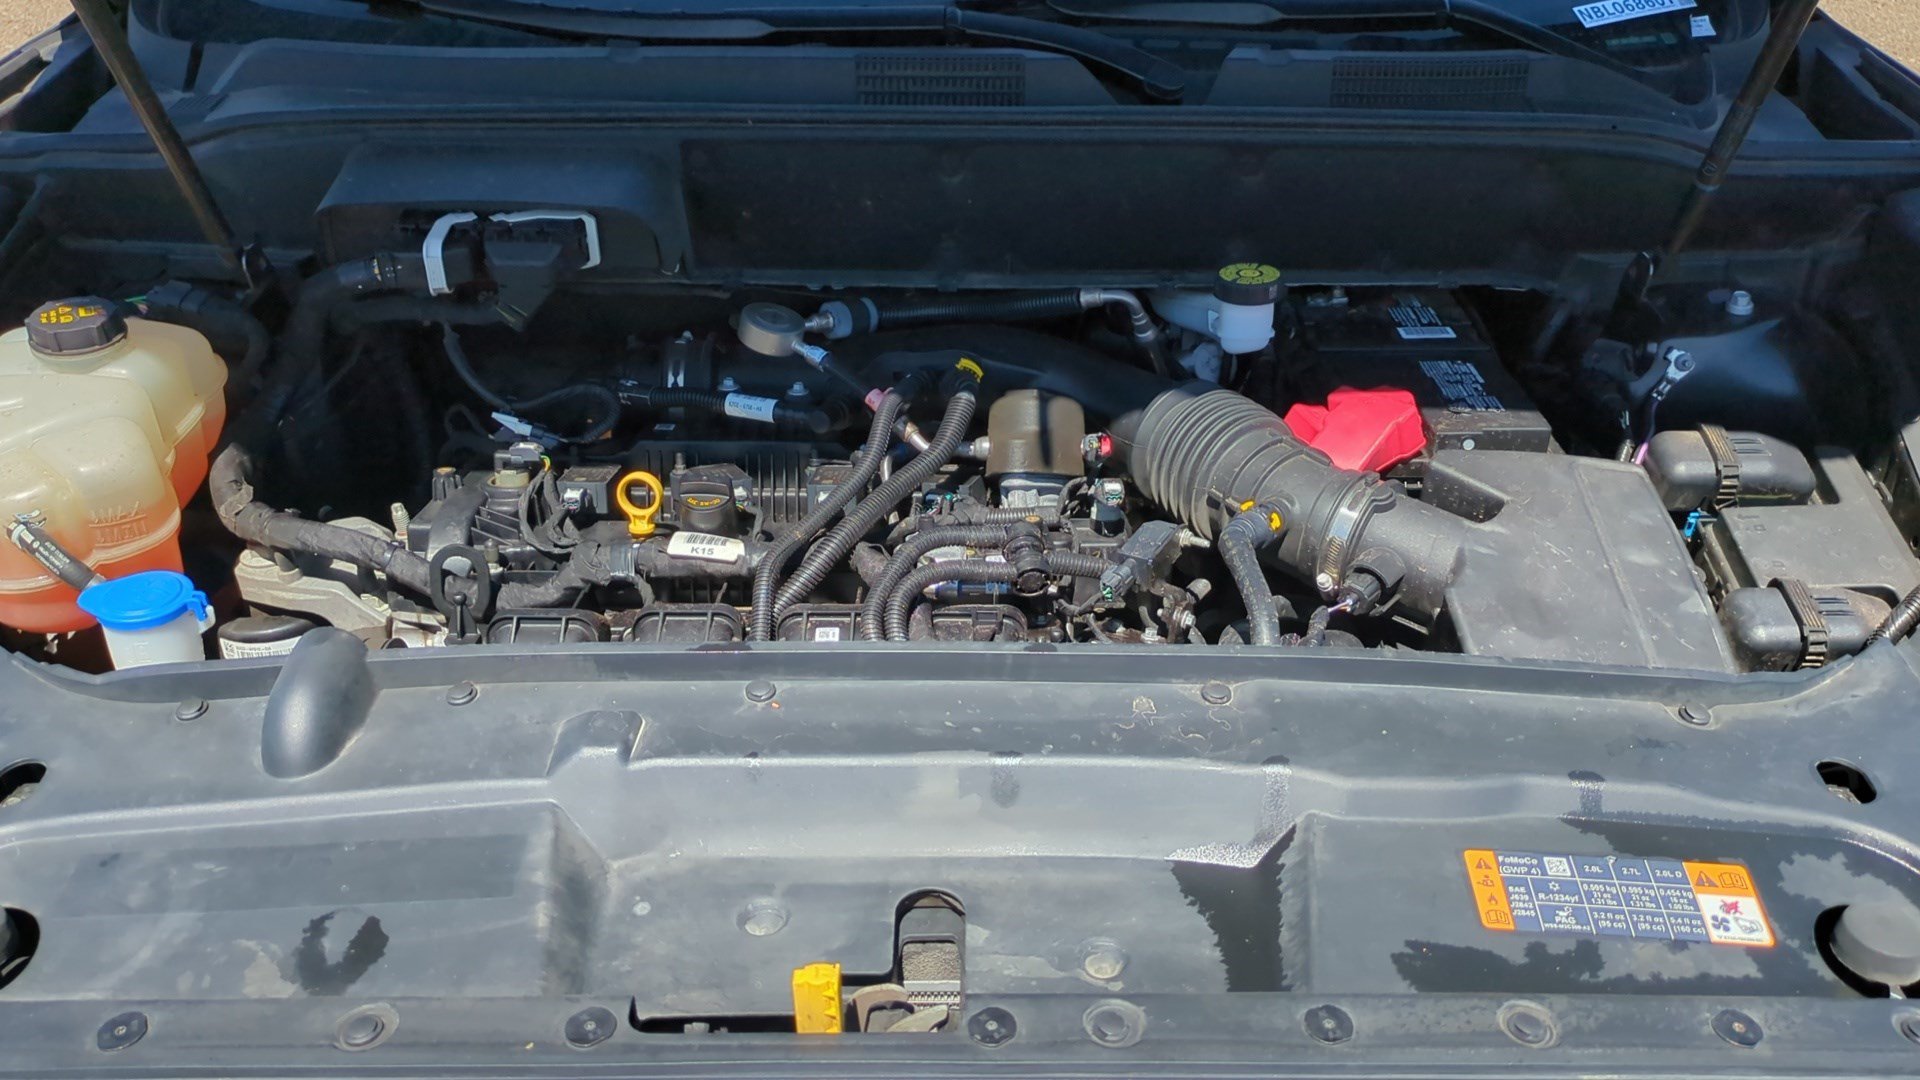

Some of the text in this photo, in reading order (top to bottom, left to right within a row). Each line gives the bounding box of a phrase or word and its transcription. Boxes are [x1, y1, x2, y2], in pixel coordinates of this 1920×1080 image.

[1577, 0, 1675, 21] NBL0686
[690, 546, 714, 555] K15
[1498, 856, 1538, 865] FoMoCo
[1500, 865, 1541, 876] (GWP 4)
[1584, 865, 1604, 873] 2.0L
[1655, 870, 1674, 878] 2.0L
[1583, 884, 1616, 894] 0.595 kg
[1622, 886, 1655, 896] 0.595 kg
[1682, 890, 1693, 899] kg
[1555, 916, 1576, 924] PAG
